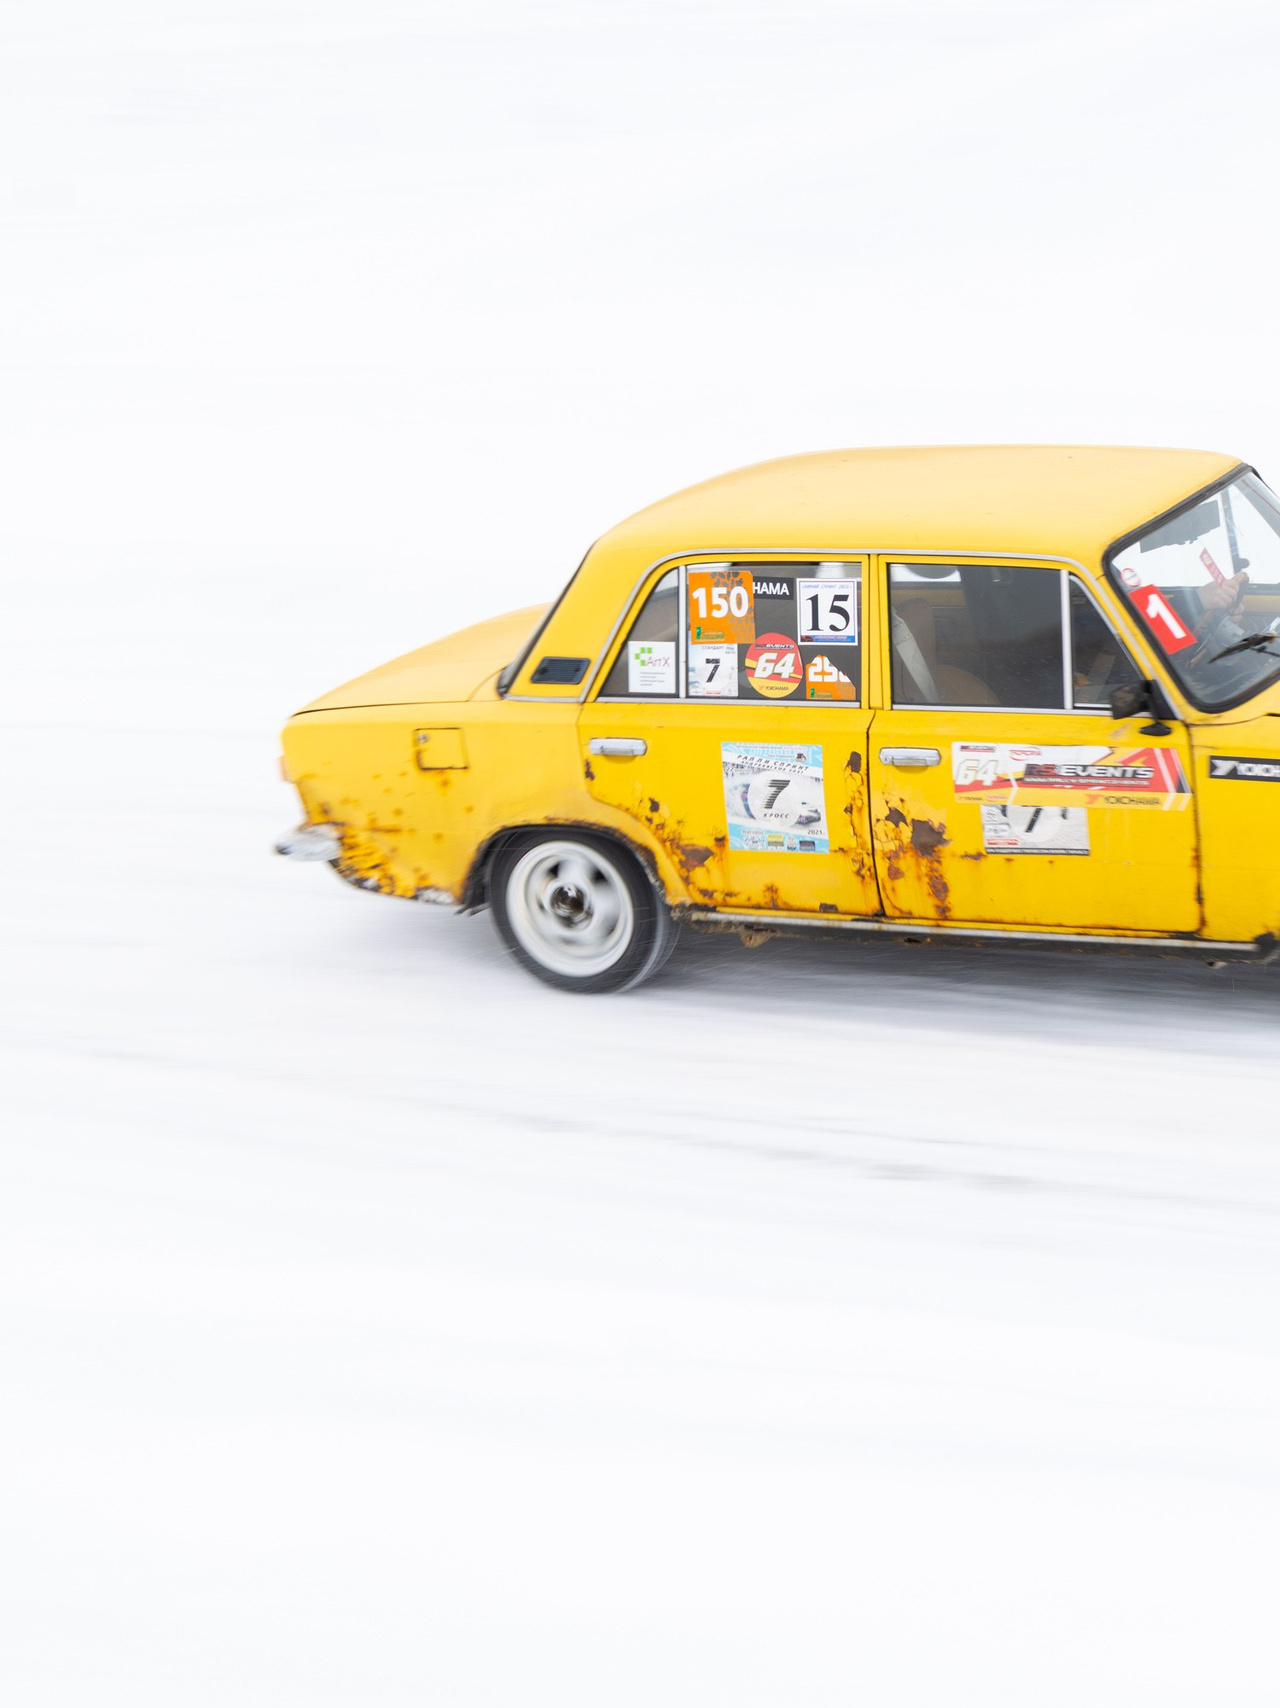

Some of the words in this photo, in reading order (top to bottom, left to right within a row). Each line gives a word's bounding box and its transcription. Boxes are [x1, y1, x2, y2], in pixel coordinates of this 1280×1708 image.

[692, 586, 749, 618] 150
[805, 594, 850, 632] 15
[1146, 593, 1187, 639] 1
[705, 658, 721, 683] 7
[753, 652, 796, 679] 64
[773, 761, 809, 771] СПРИНТ
[955, 758, 999, 786] 64
[1058, 765, 1155, 779] EVENTS
[763, 779, 791, 809] 7
